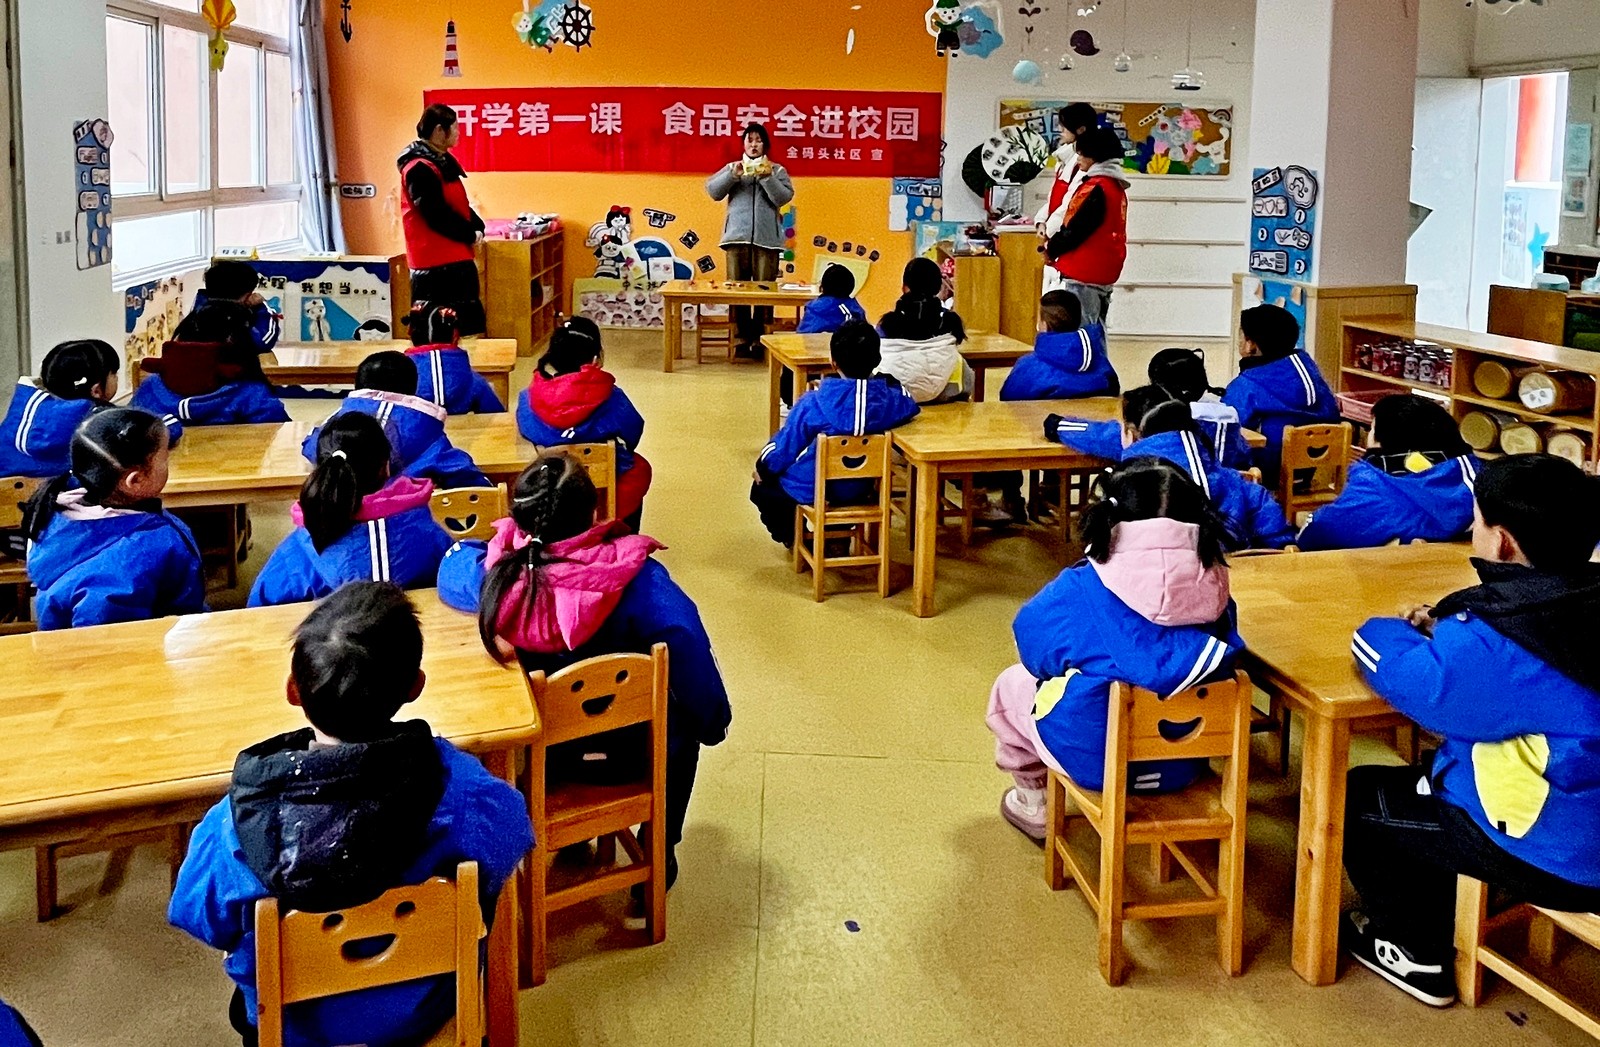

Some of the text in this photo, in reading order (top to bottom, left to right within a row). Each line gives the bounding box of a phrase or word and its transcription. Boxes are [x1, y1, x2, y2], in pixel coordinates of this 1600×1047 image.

[447, 101, 919, 141] 开学第一课 食品安全进校园
[786, 146, 883, 161] 金码头社区 宣
